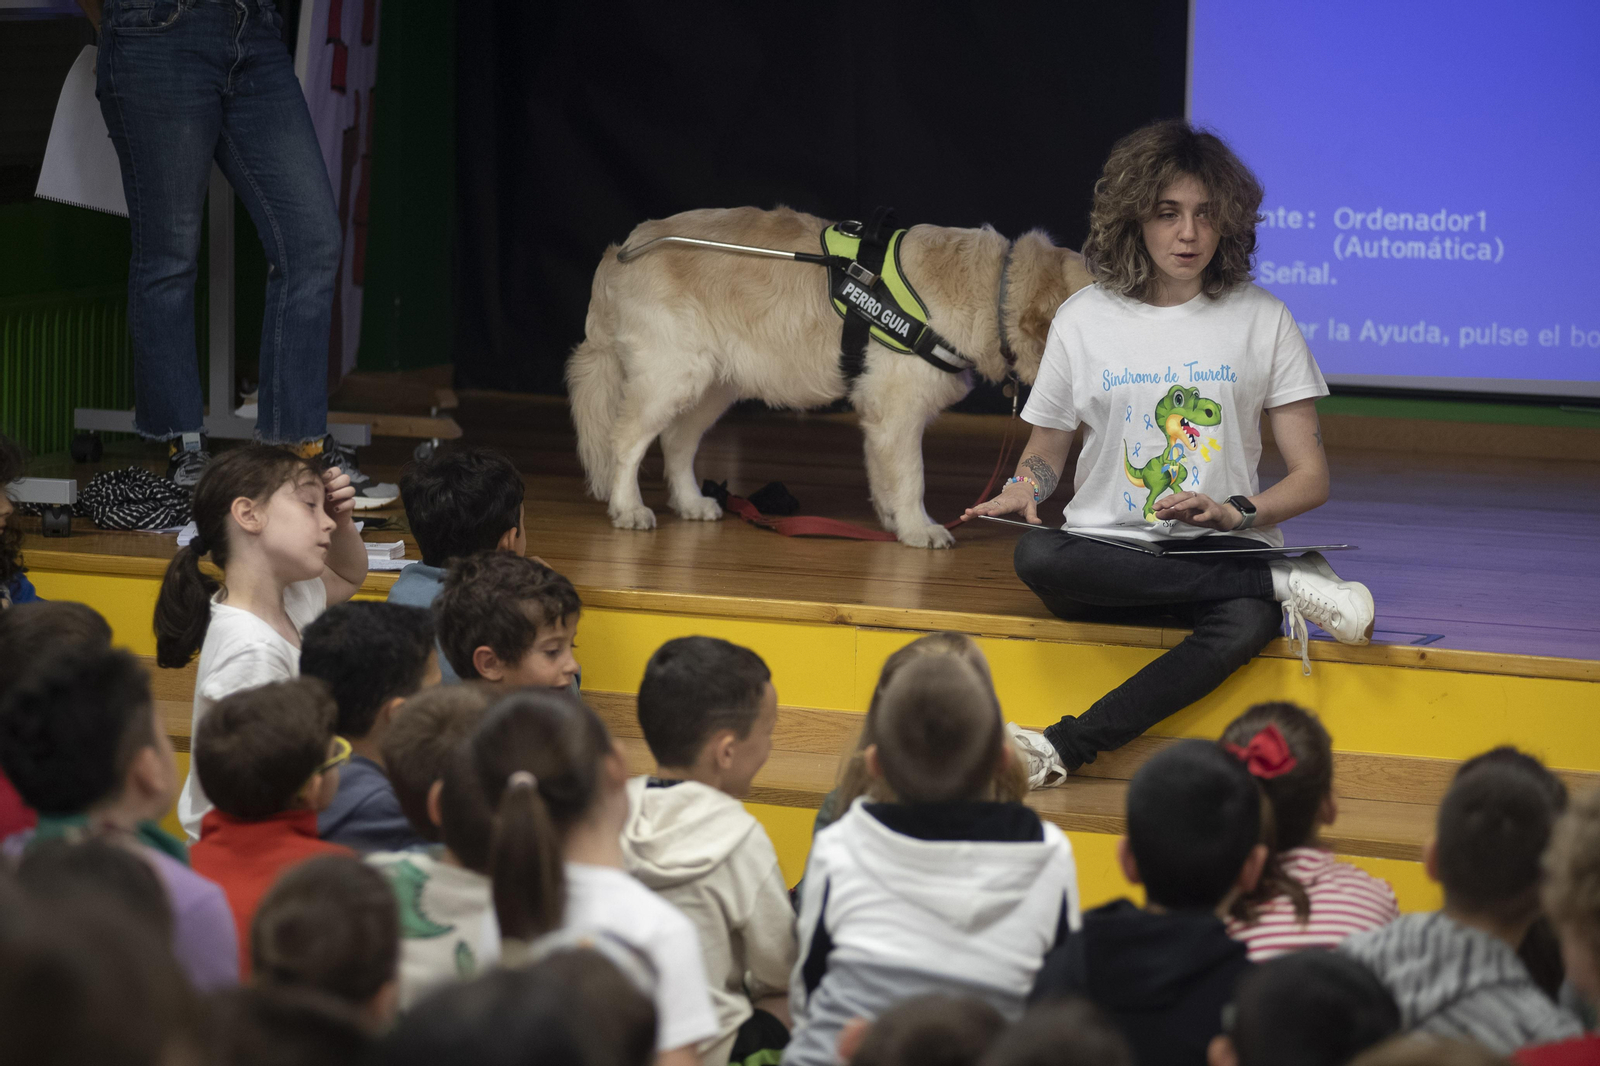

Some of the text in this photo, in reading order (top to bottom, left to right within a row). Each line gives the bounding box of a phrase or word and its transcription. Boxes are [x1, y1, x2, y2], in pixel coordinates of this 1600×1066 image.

[1333, 207, 1487, 232] Ordenador1
[1333, 233, 1505, 264] (Automática)
[1260, 261, 1338, 285] Señal.
[842, 282, 882, 317] PERRO
[881, 309, 911, 338] GUIA
[1328, 317, 1350, 341] la
[1359, 319, 1449, 347] Ayuda,
[1459, 322, 1529, 349] pulse
[1538, 324, 1560, 347] el
[1164, 366, 1179, 383] de
[1183, 360, 1238, 383] Tourette
